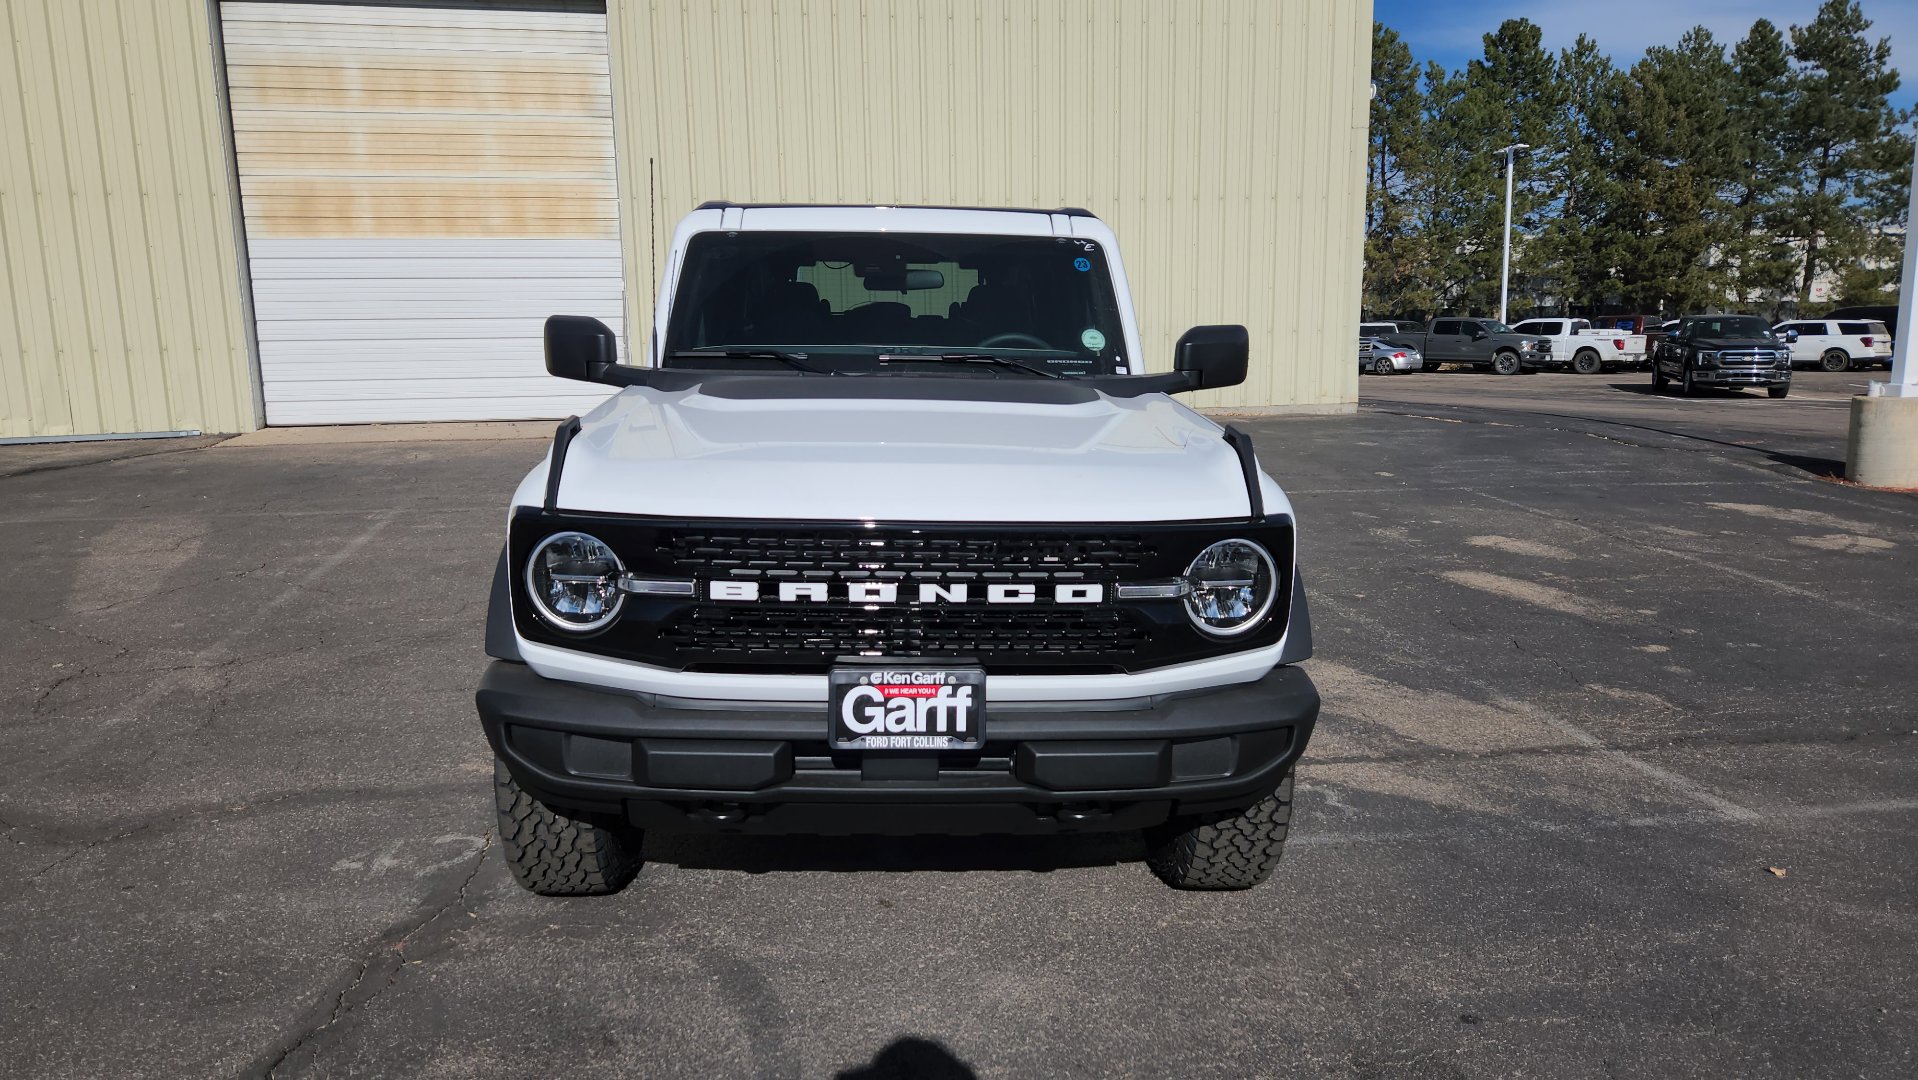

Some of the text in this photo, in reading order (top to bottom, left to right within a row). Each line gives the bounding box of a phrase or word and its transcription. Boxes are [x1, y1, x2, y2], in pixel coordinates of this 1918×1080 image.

[1075, 260, 1088, 269] 23
[709, 580, 1103, 604] BRONCO
[883, 672, 911, 685] Ken
[911, 672, 946, 685] Garff
[889, 687, 931, 695] WE HEAR YOU
[841, 685, 973, 734] Garff
[865, 736, 949, 748] FORD FORT COLLINS
